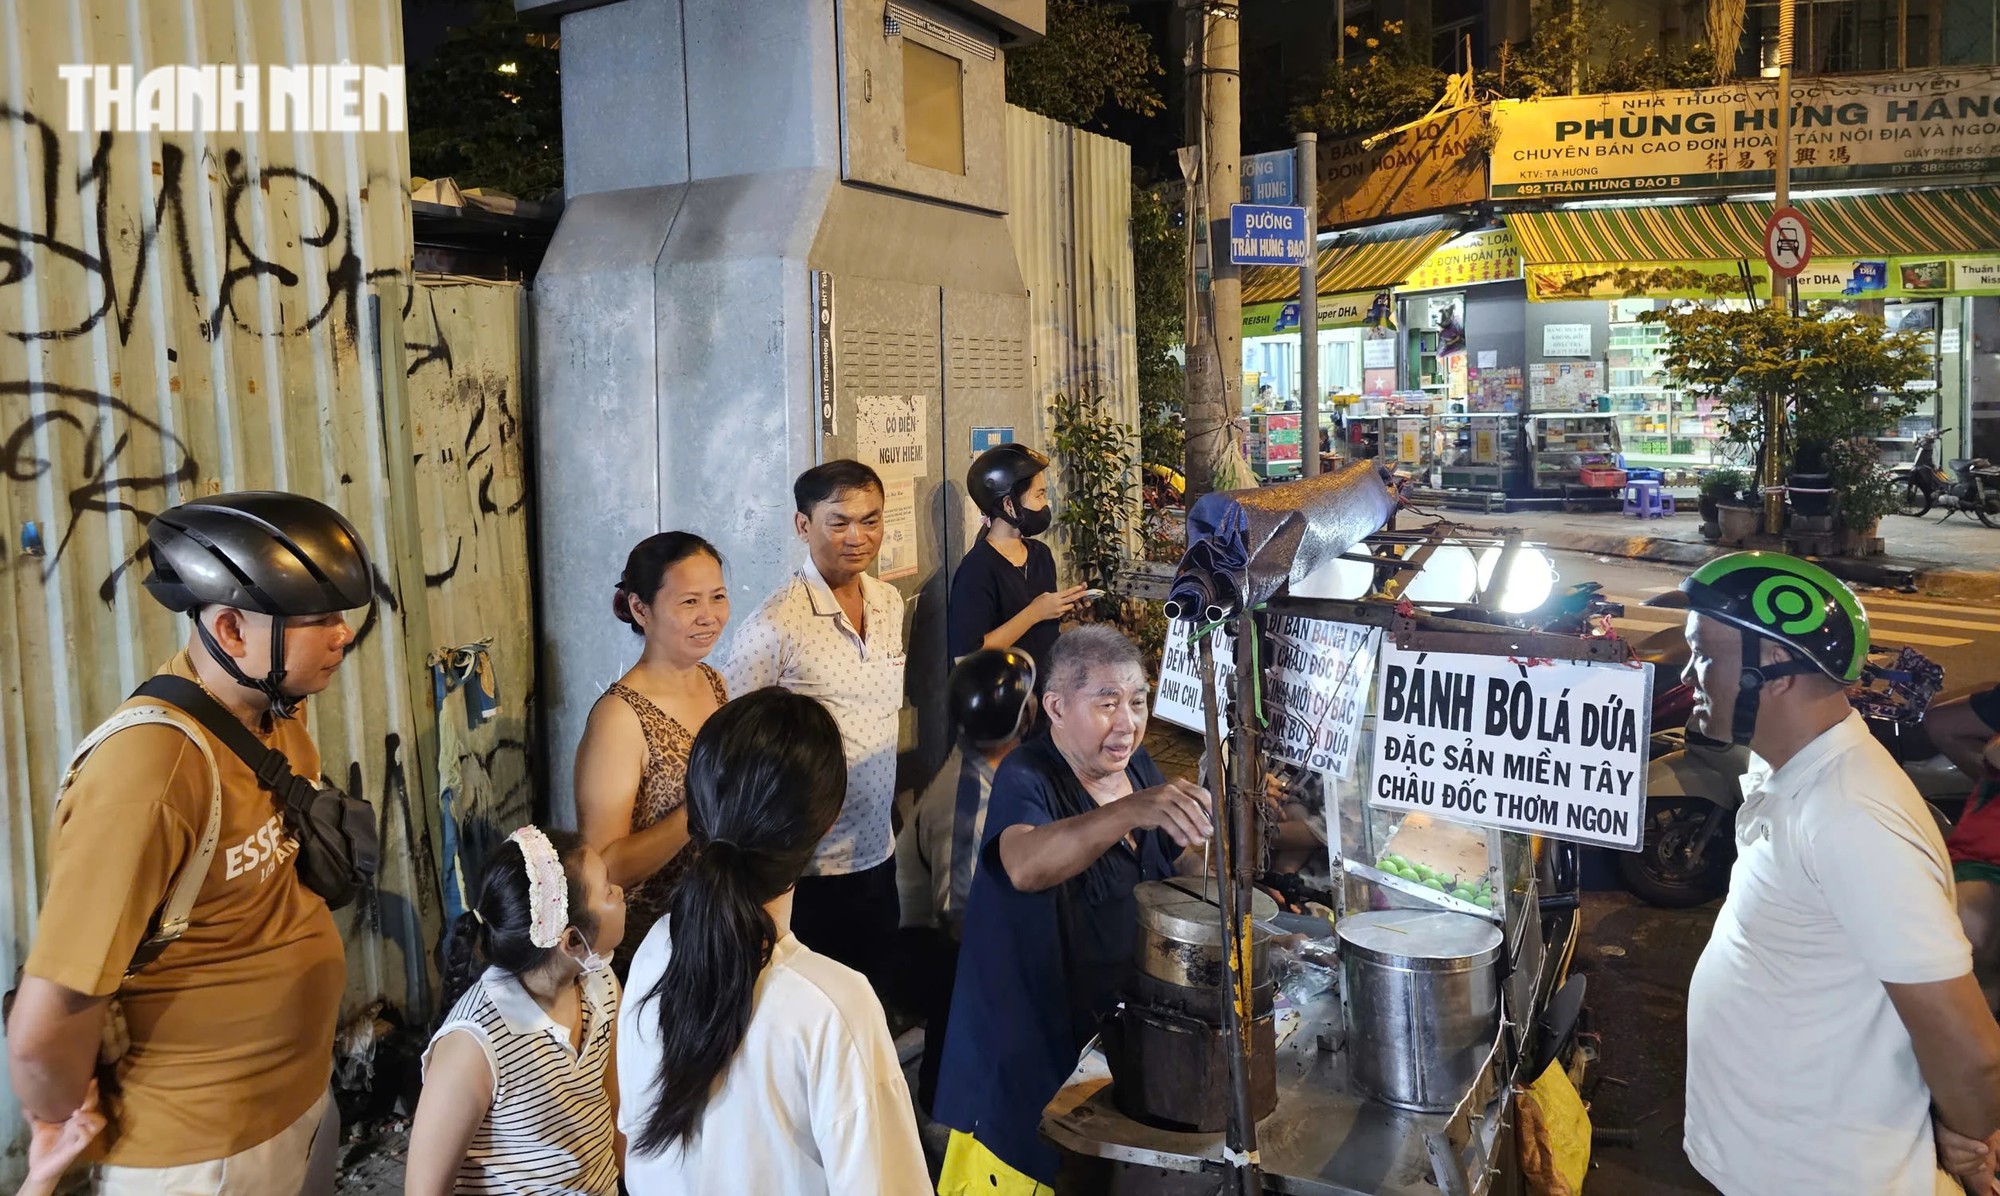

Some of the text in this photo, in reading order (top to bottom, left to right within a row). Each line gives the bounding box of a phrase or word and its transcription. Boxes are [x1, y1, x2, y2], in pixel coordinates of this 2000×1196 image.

[1676, 90, 1746, 106] THUỐC
[1555, 110, 1716, 142] PHÙNG
[1733, 101, 1869, 132] HƯNG
[1514, 146, 1590, 161] CHUYÊN
[1596, 142, 1634, 156] BÁN
[1641, 141, 1680, 154] CAO
[1686, 137, 1726, 151] ĐƠN
[1734, 134, 1778, 148] HOÀ
[1794, 130, 1832, 145] TÁN
[1841, 127, 1873, 144] NỘI
[1880, 127, 1912, 143] ĐỊA
[1920, 123, 1945, 138] VÀ
[1517, 184, 1541, 194] 492
[1589, 178, 1631, 191] HƯNG
[1634, 177, 1666, 190] ĐẠO
[1670, 176, 1681, 186] B
[1519, 170, 1543, 179] KTV:
[1245, 210, 1293, 230] ĐƯỜNG
[1231, 229, 1306, 262] TRẦN HƯNG ĐẠO
[1813, 275, 1841, 285] DHA
[1242, 315, 1270, 326] REISHI
[1317, 306, 1358, 322] uper DHA
[822, 337, 830, 383] Technology
[879, 447, 901, 465] NGUY
[1165, 641, 1186, 674] ĐẾN
[1308, 649, 1334, 680] ĐỐC
[1160, 679, 1181, 703] ANH
[1181, 685, 1199, 714] CHỊ
[1330, 692, 1356, 725] BÁC
[1383, 652, 1637, 754] BÁNH BÒ LÁ DỨA
[1324, 726, 1349, 758] DỨA
[1311, 752, 1342, 774] ƠN
[1384, 734, 1635, 797] ĐẶC SẢN MIỀN TÂY
[1377, 771, 1629, 837] CHÂU ĐỐC THƠM NGON
